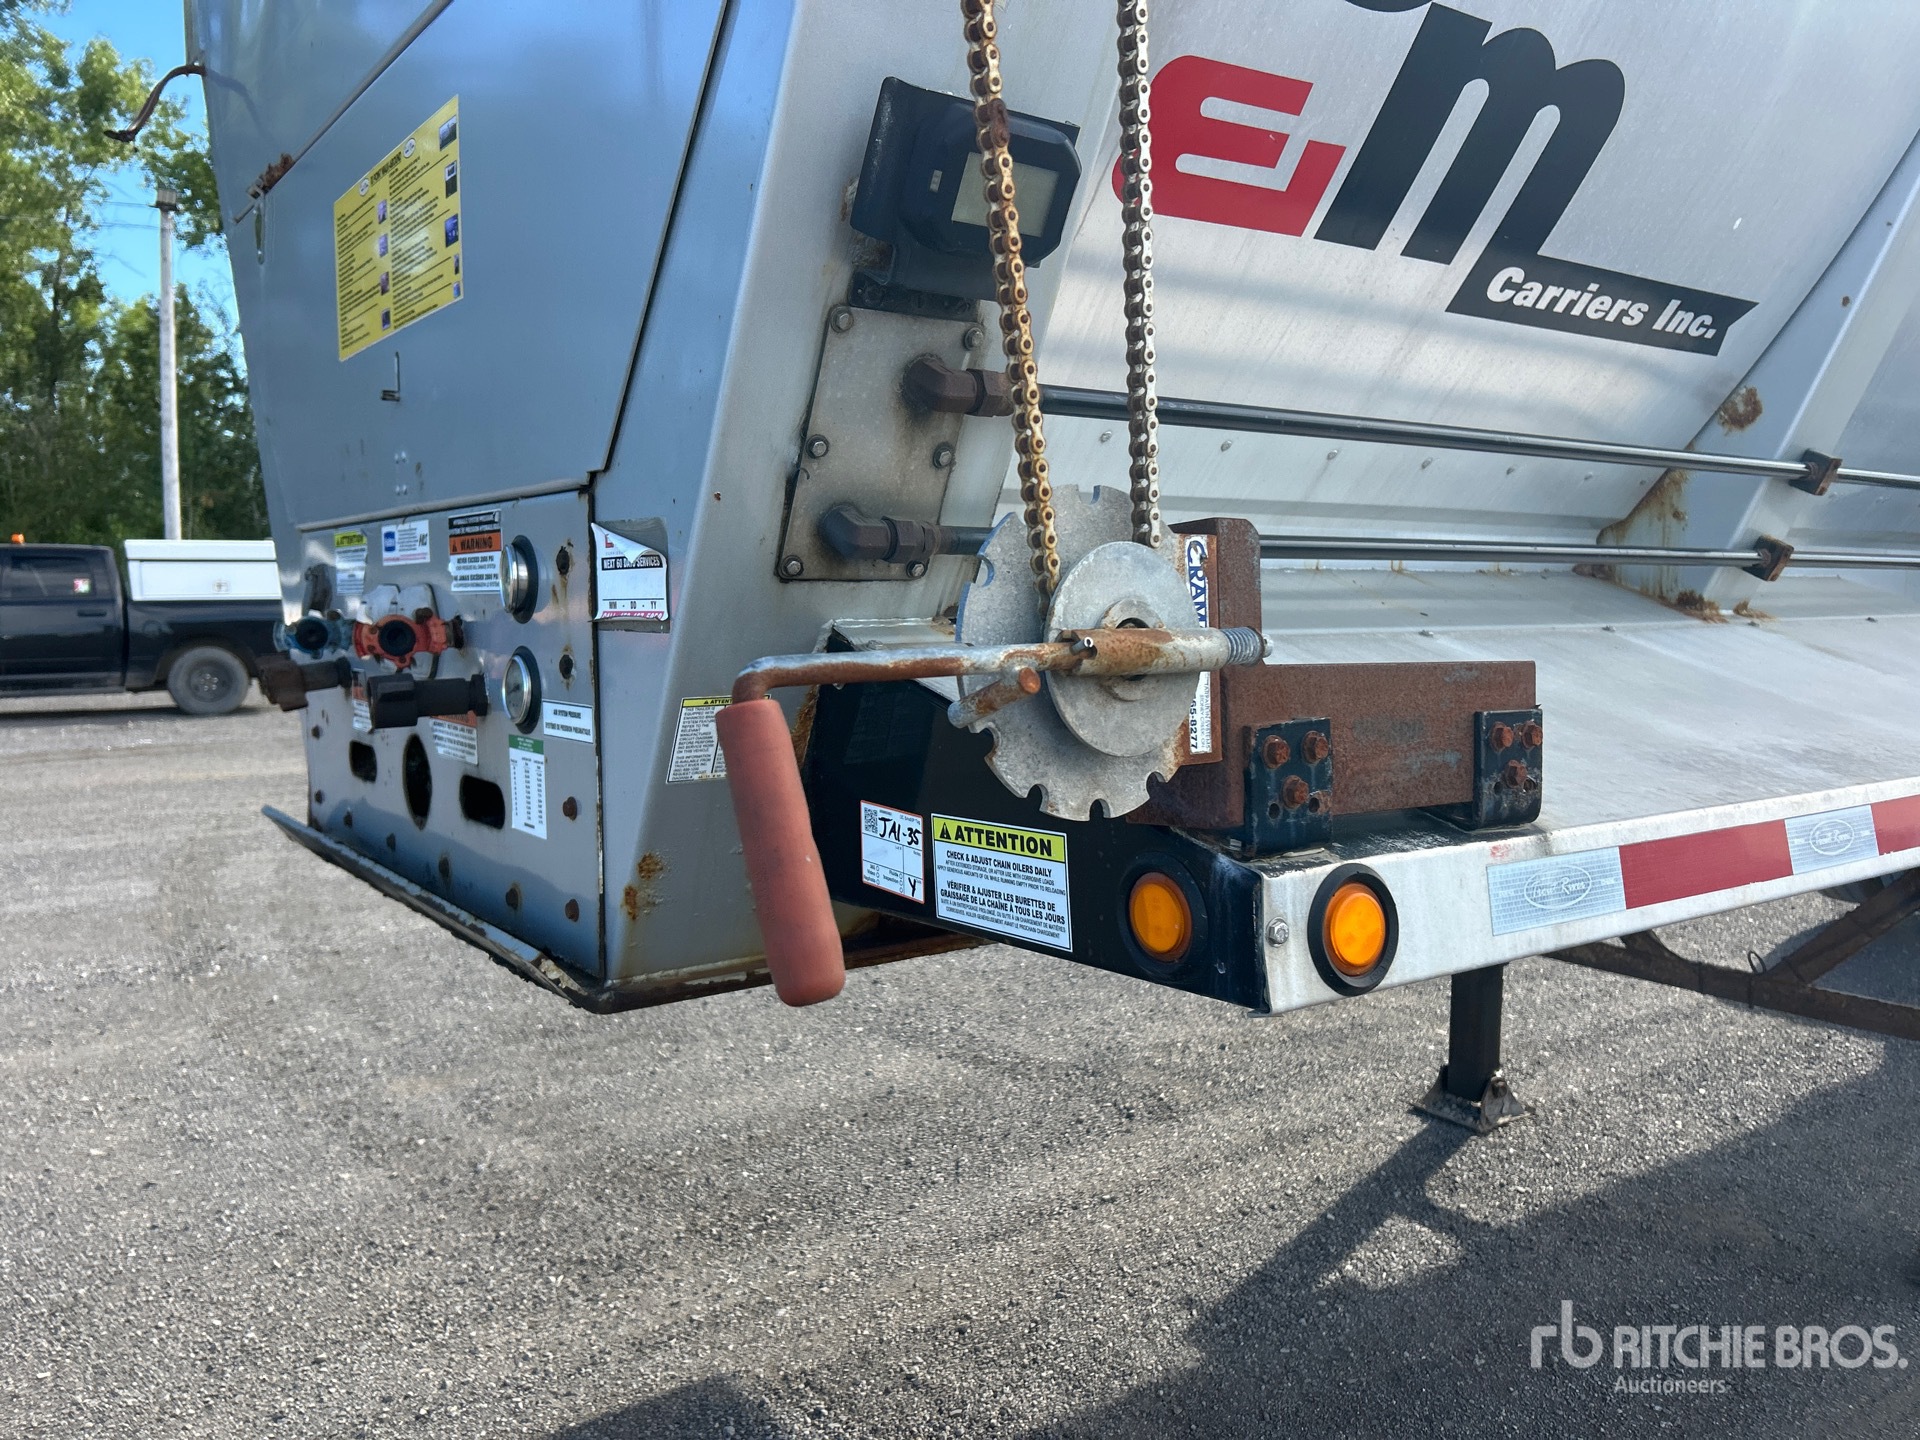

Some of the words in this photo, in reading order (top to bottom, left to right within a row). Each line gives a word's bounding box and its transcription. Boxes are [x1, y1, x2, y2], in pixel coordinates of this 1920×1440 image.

[1486, 266, 1649, 326] Carriers
[1652, 299, 1718, 339] Inc.
[461, 536, 492, 551] WARNING
[603, 558, 616, 569] NEXT
[636, 555, 660, 567] SERVICES
[954, 825, 1052, 857] ATTENTION
[947, 850, 965, 861] CHECK
[966, 854, 970, 862] &
[971, 855, 992, 866] ADJUST
[994, 859, 1011, 870] CHAIN
[1013, 862, 1033, 874] OILERS
[1035, 866, 1052, 878] DAILY
[941, 889, 969, 903] GRAISSAGE
[971, 896, 978, 904] DE
[979, 897, 986, 907] LA
[1015, 906, 1031, 917] TOUS
[1032, 910, 1043, 920] LES
[1045, 912, 1065, 925] JOURS
[947, 879, 970, 893] VÉRIFIER
[972, 886, 976, 894] &
[977, 887, 1002, 900] AJUSTER
[1004, 893, 1014, 903] LES
[1015, 895, 1046, 910] BURETTES
[1048, 902, 1056, 912] DE
